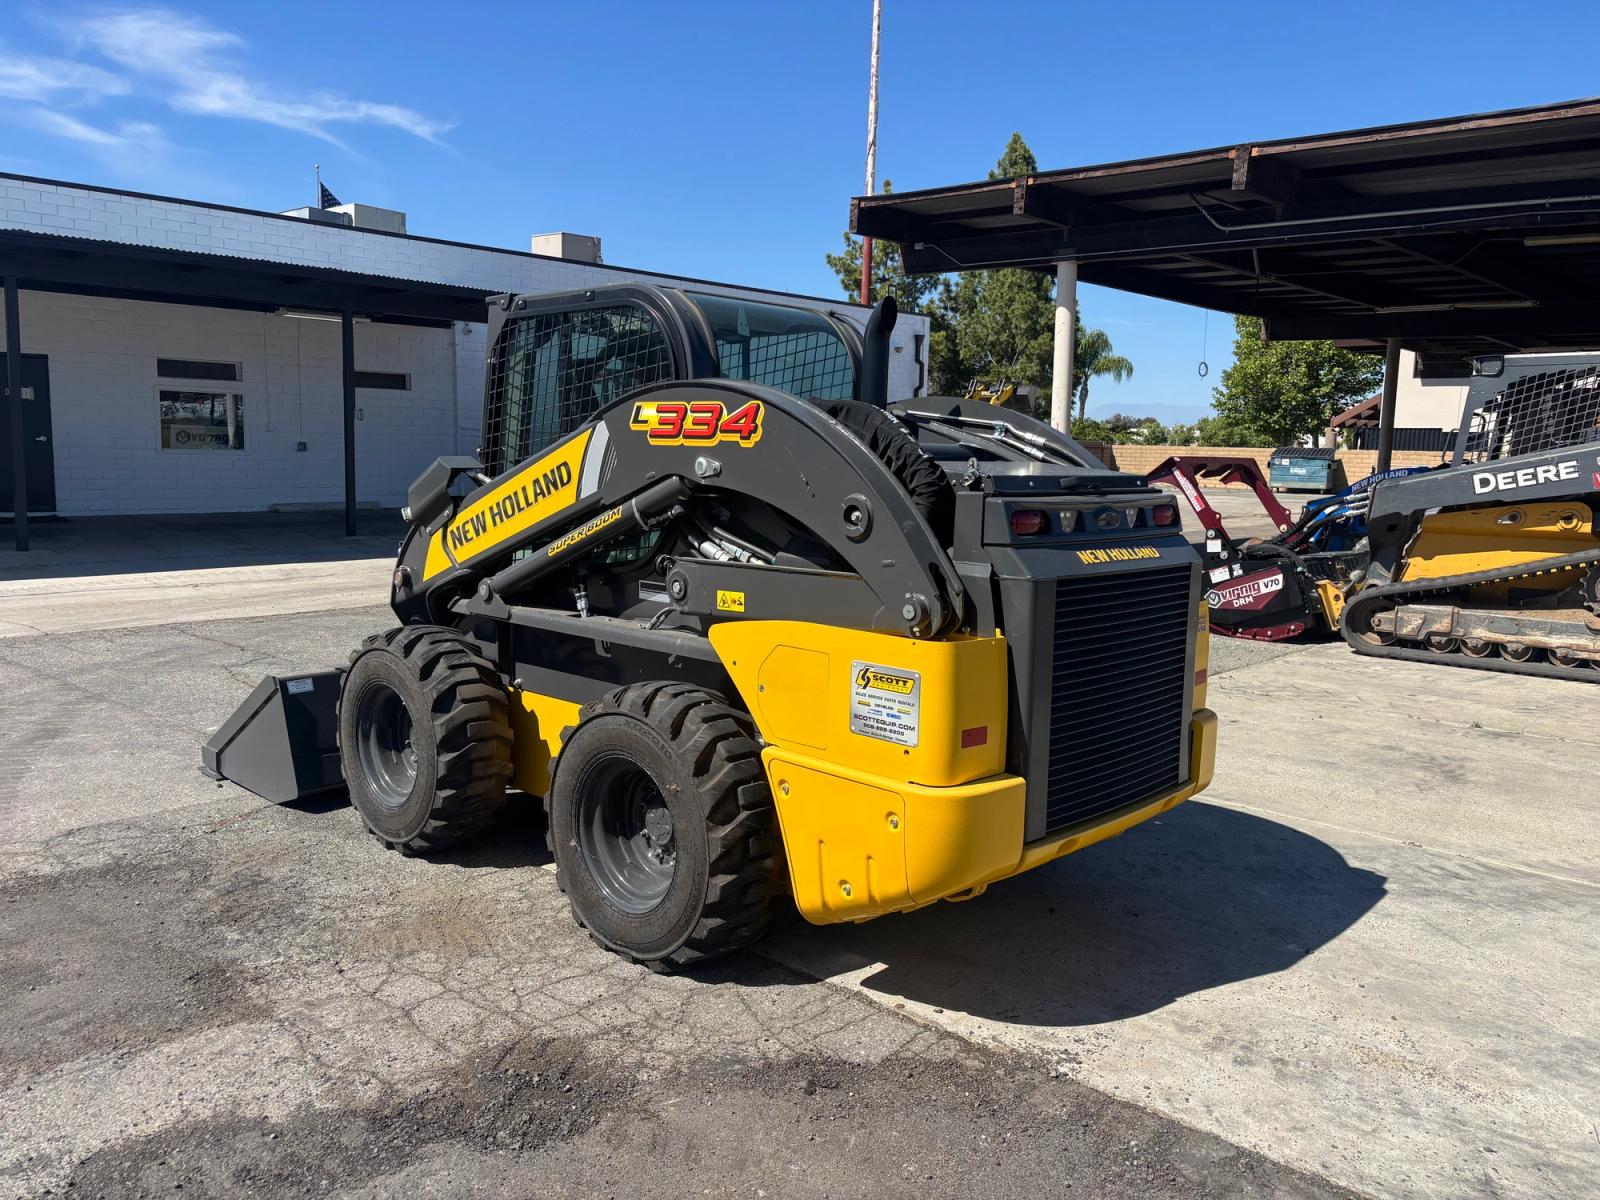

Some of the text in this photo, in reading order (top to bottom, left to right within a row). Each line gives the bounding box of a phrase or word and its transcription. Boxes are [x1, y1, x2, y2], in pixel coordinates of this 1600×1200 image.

[630, 401, 763, 446] L334
[1473, 461, 1579, 494] DEERE
[449, 461, 573, 551] NEW HOLLAND
[547, 506, 622, 556] SUPER BOOM
[1076, 546, 1161, 565] NEW HOLLAND
[1263, 579, 1280, 589] V70
[1233, 596, 1254, 607] DRM
[872, 674, 909, 687] SCOTT
